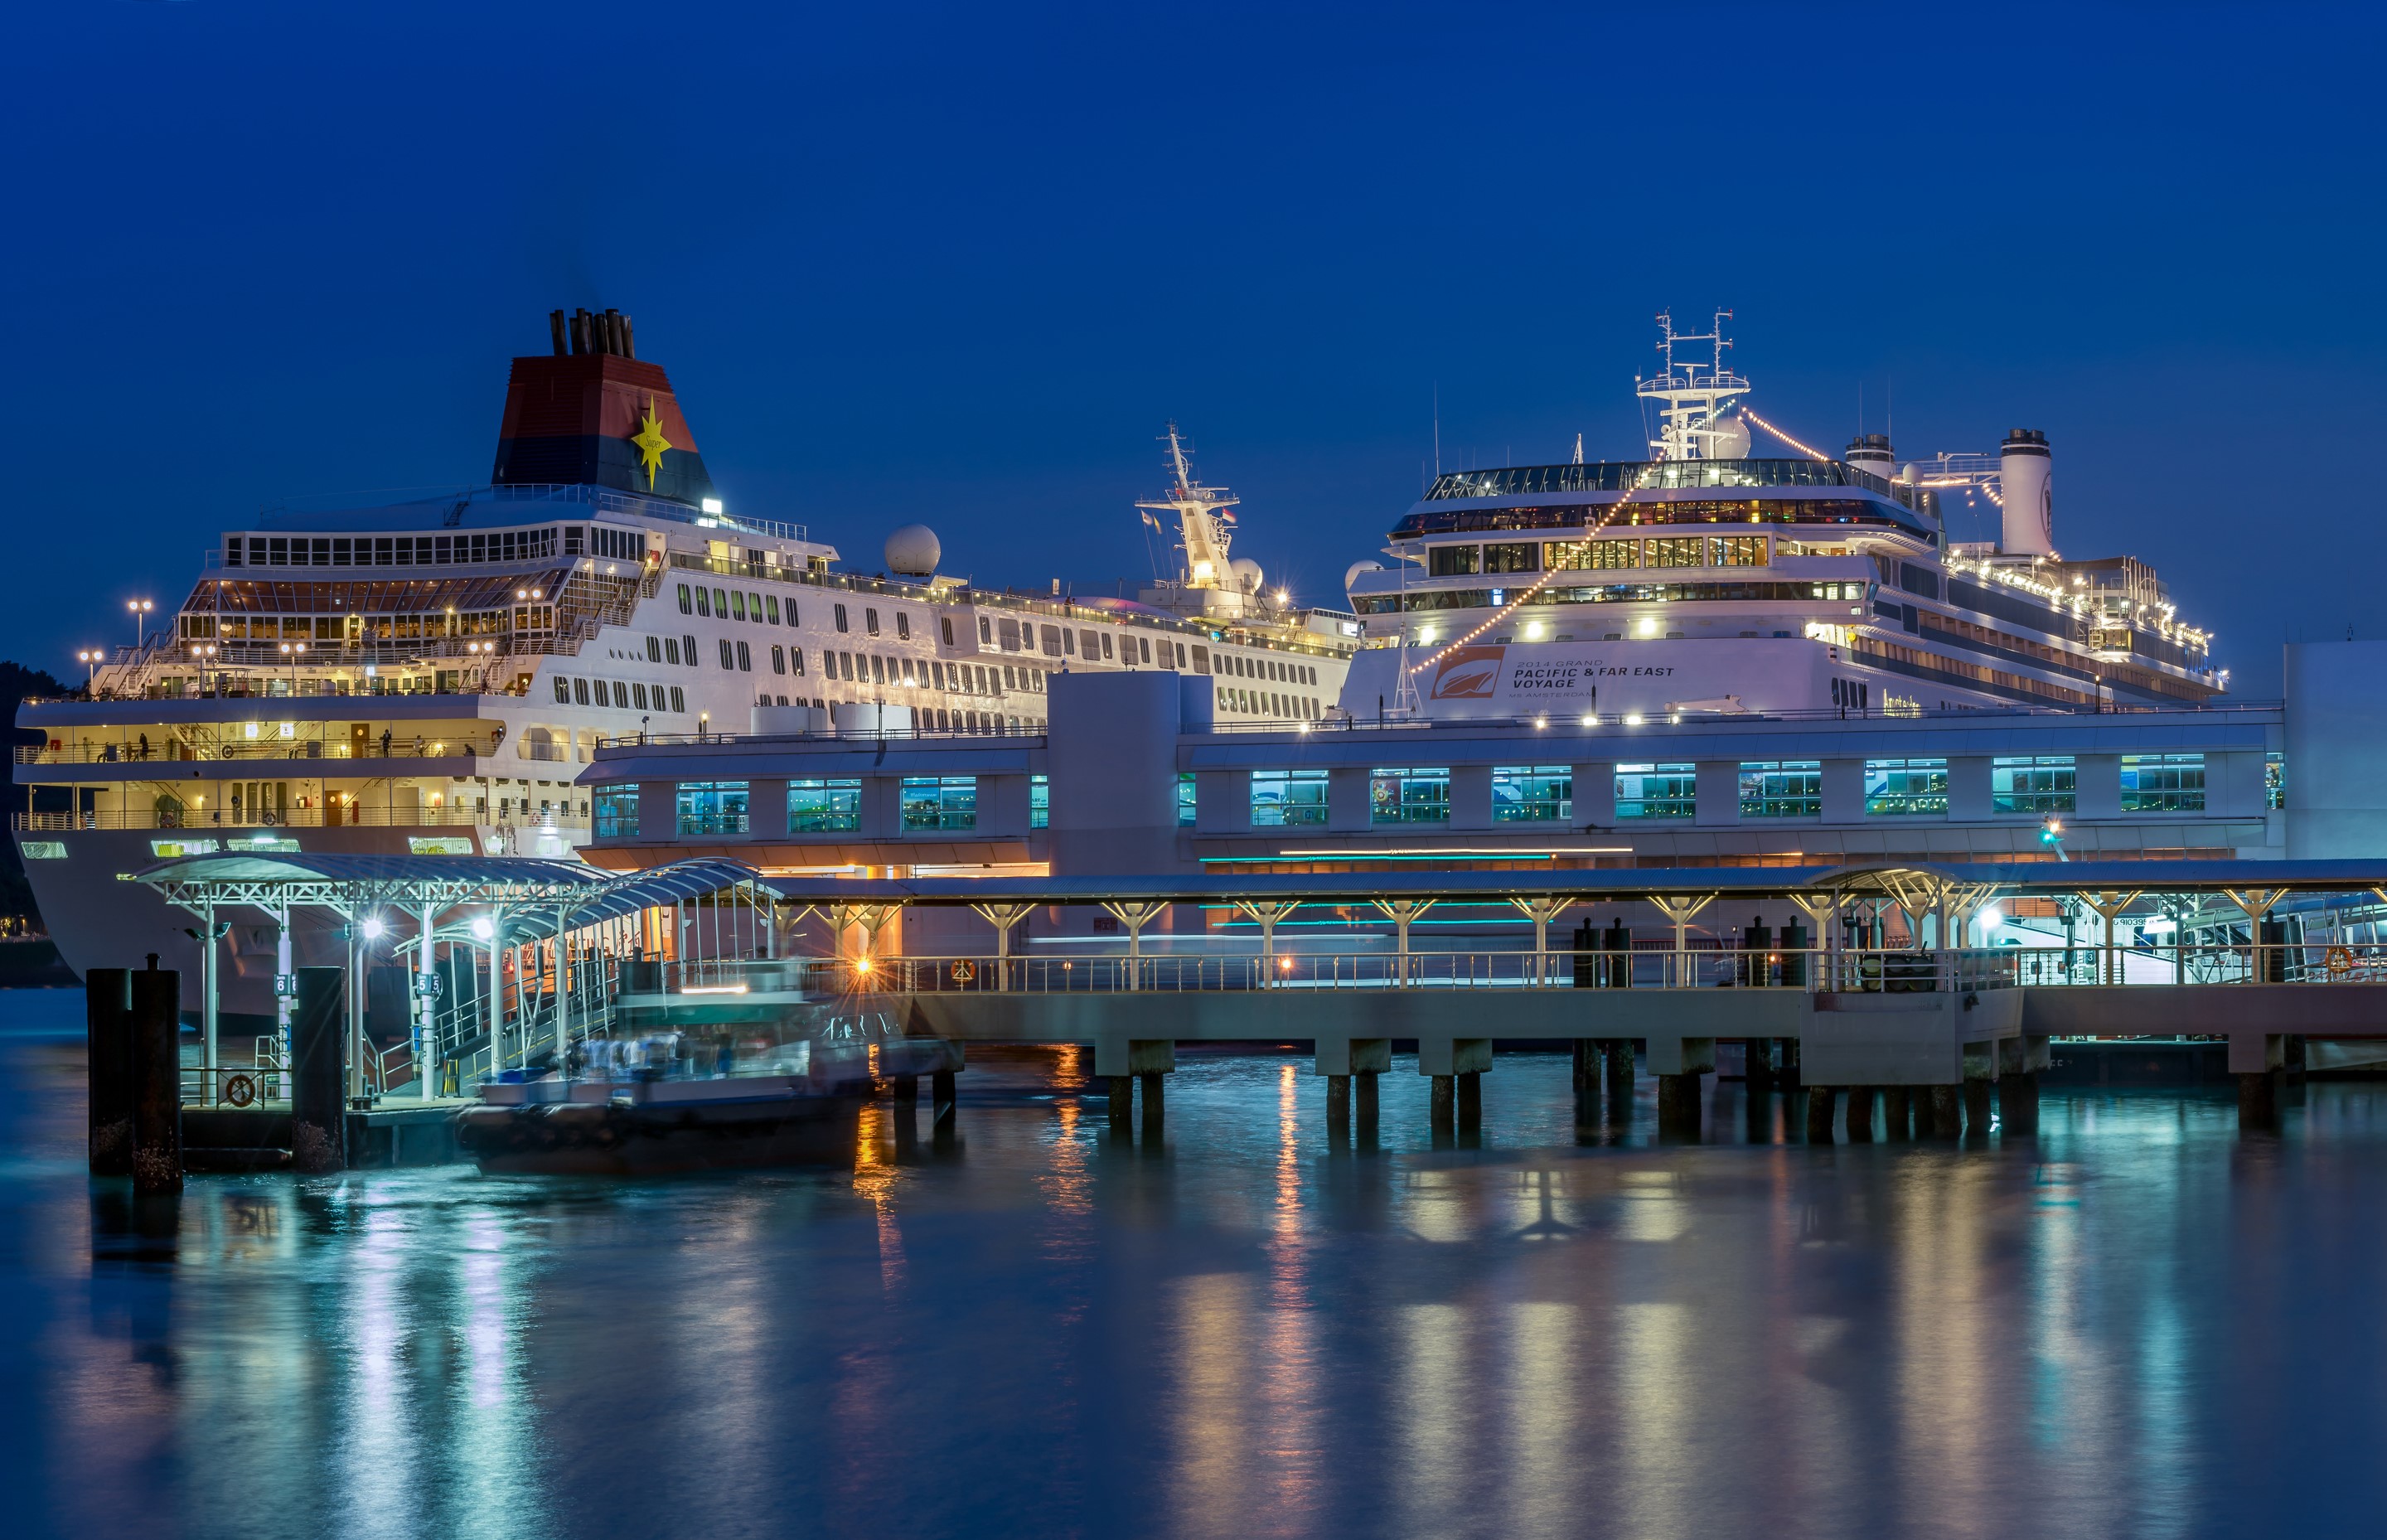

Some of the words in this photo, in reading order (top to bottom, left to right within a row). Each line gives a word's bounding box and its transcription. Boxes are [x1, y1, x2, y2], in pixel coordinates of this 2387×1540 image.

[646, 435, 661, 451] Super
[1515, 669, 1578, 678] PACIFIC
[1584, 668, 1594, 676] &
[1599, 667, 1628, 676] FAR
[1634, 667, 1674, 676] EAST
[1513, 679, 1576, 689] VOYAGE
[2088, 953, 2094, 961] 3
[277, 980, 285, 991] 6
[419, 979, 426, 990] 5
[433, 979, 439, 990] 5
